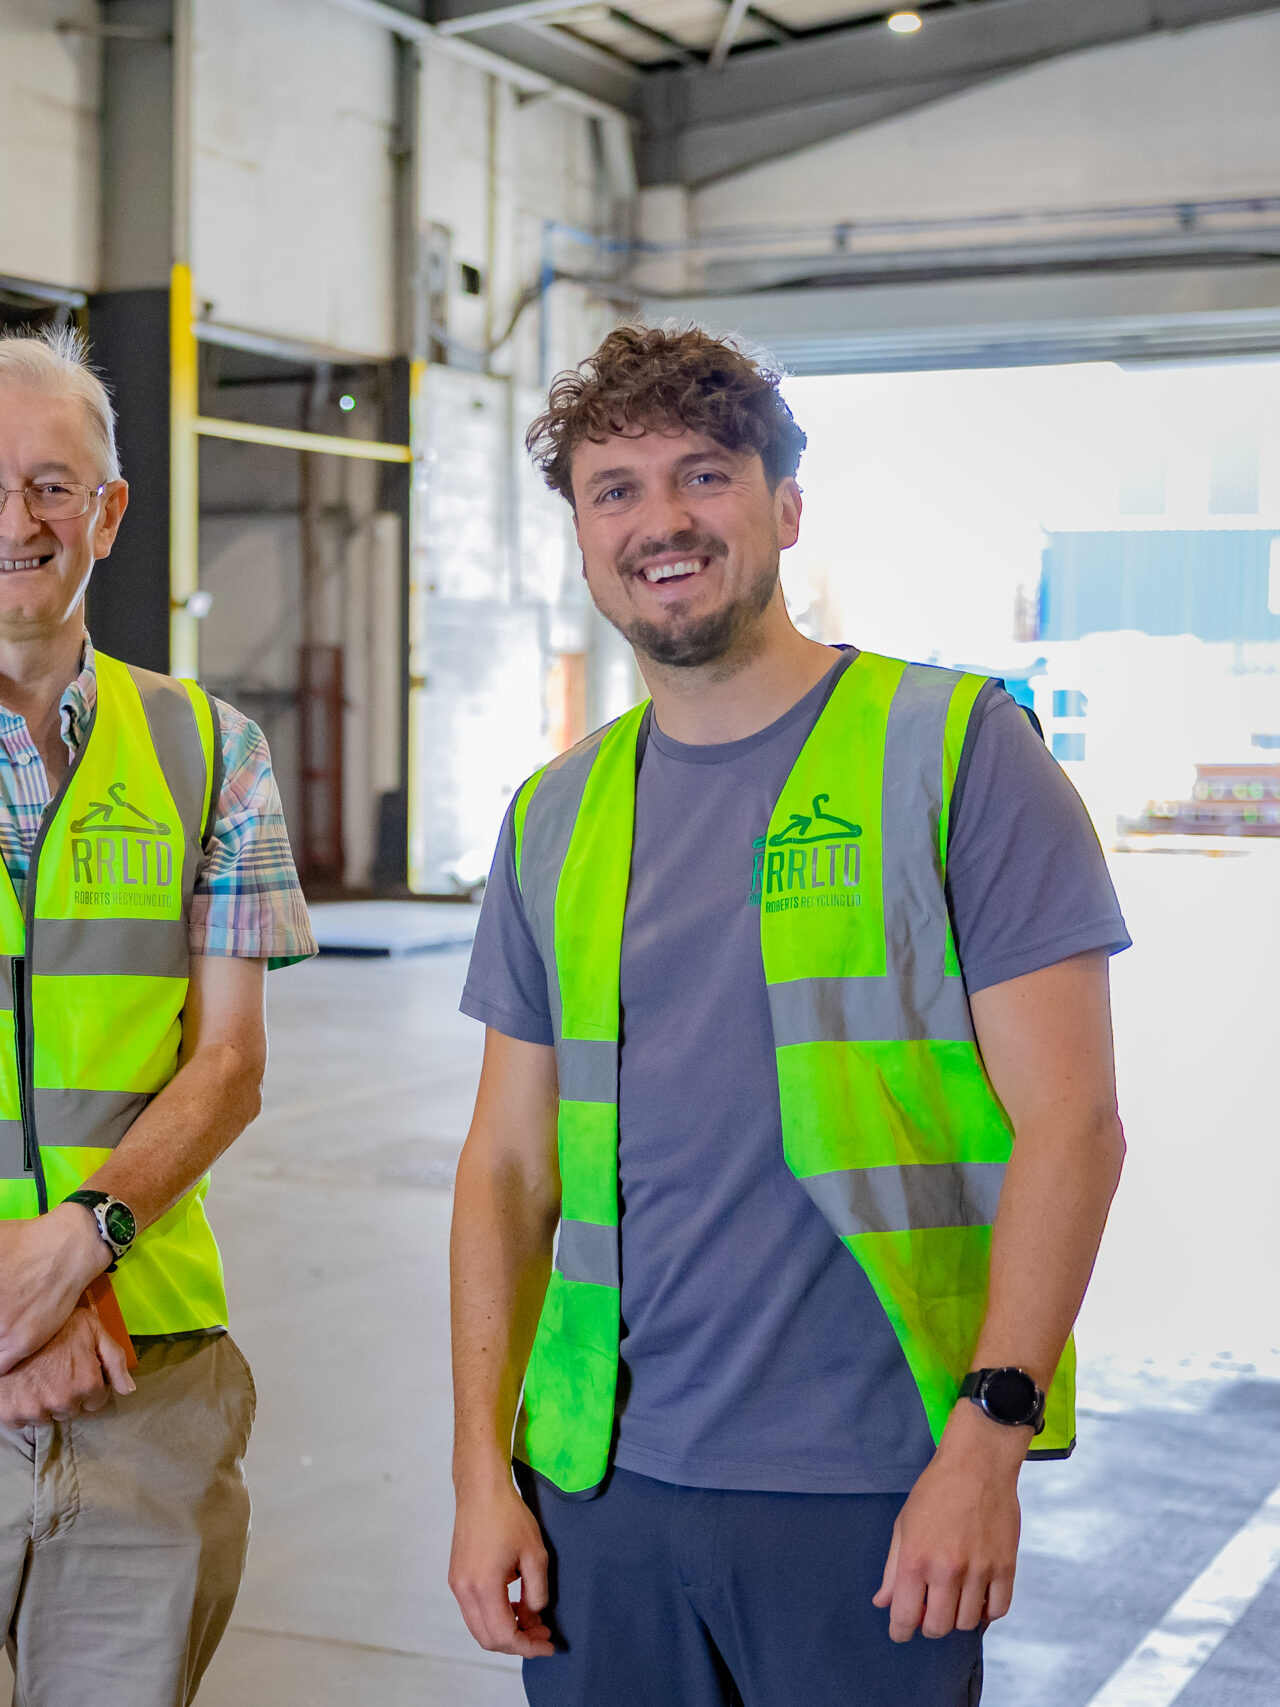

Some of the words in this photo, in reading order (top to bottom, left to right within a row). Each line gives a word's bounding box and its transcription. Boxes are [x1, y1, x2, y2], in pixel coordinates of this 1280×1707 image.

[74, 891, 110, 905] ROBERTS
[112, 892, 157, 907] RECYCLING
[158, 894, 172, 908] LTD
[765, 896, 799, 913] ROBERTS
[801, 894, 846, 909] RECYCLING
[846, 894, 861, 907] LTD
